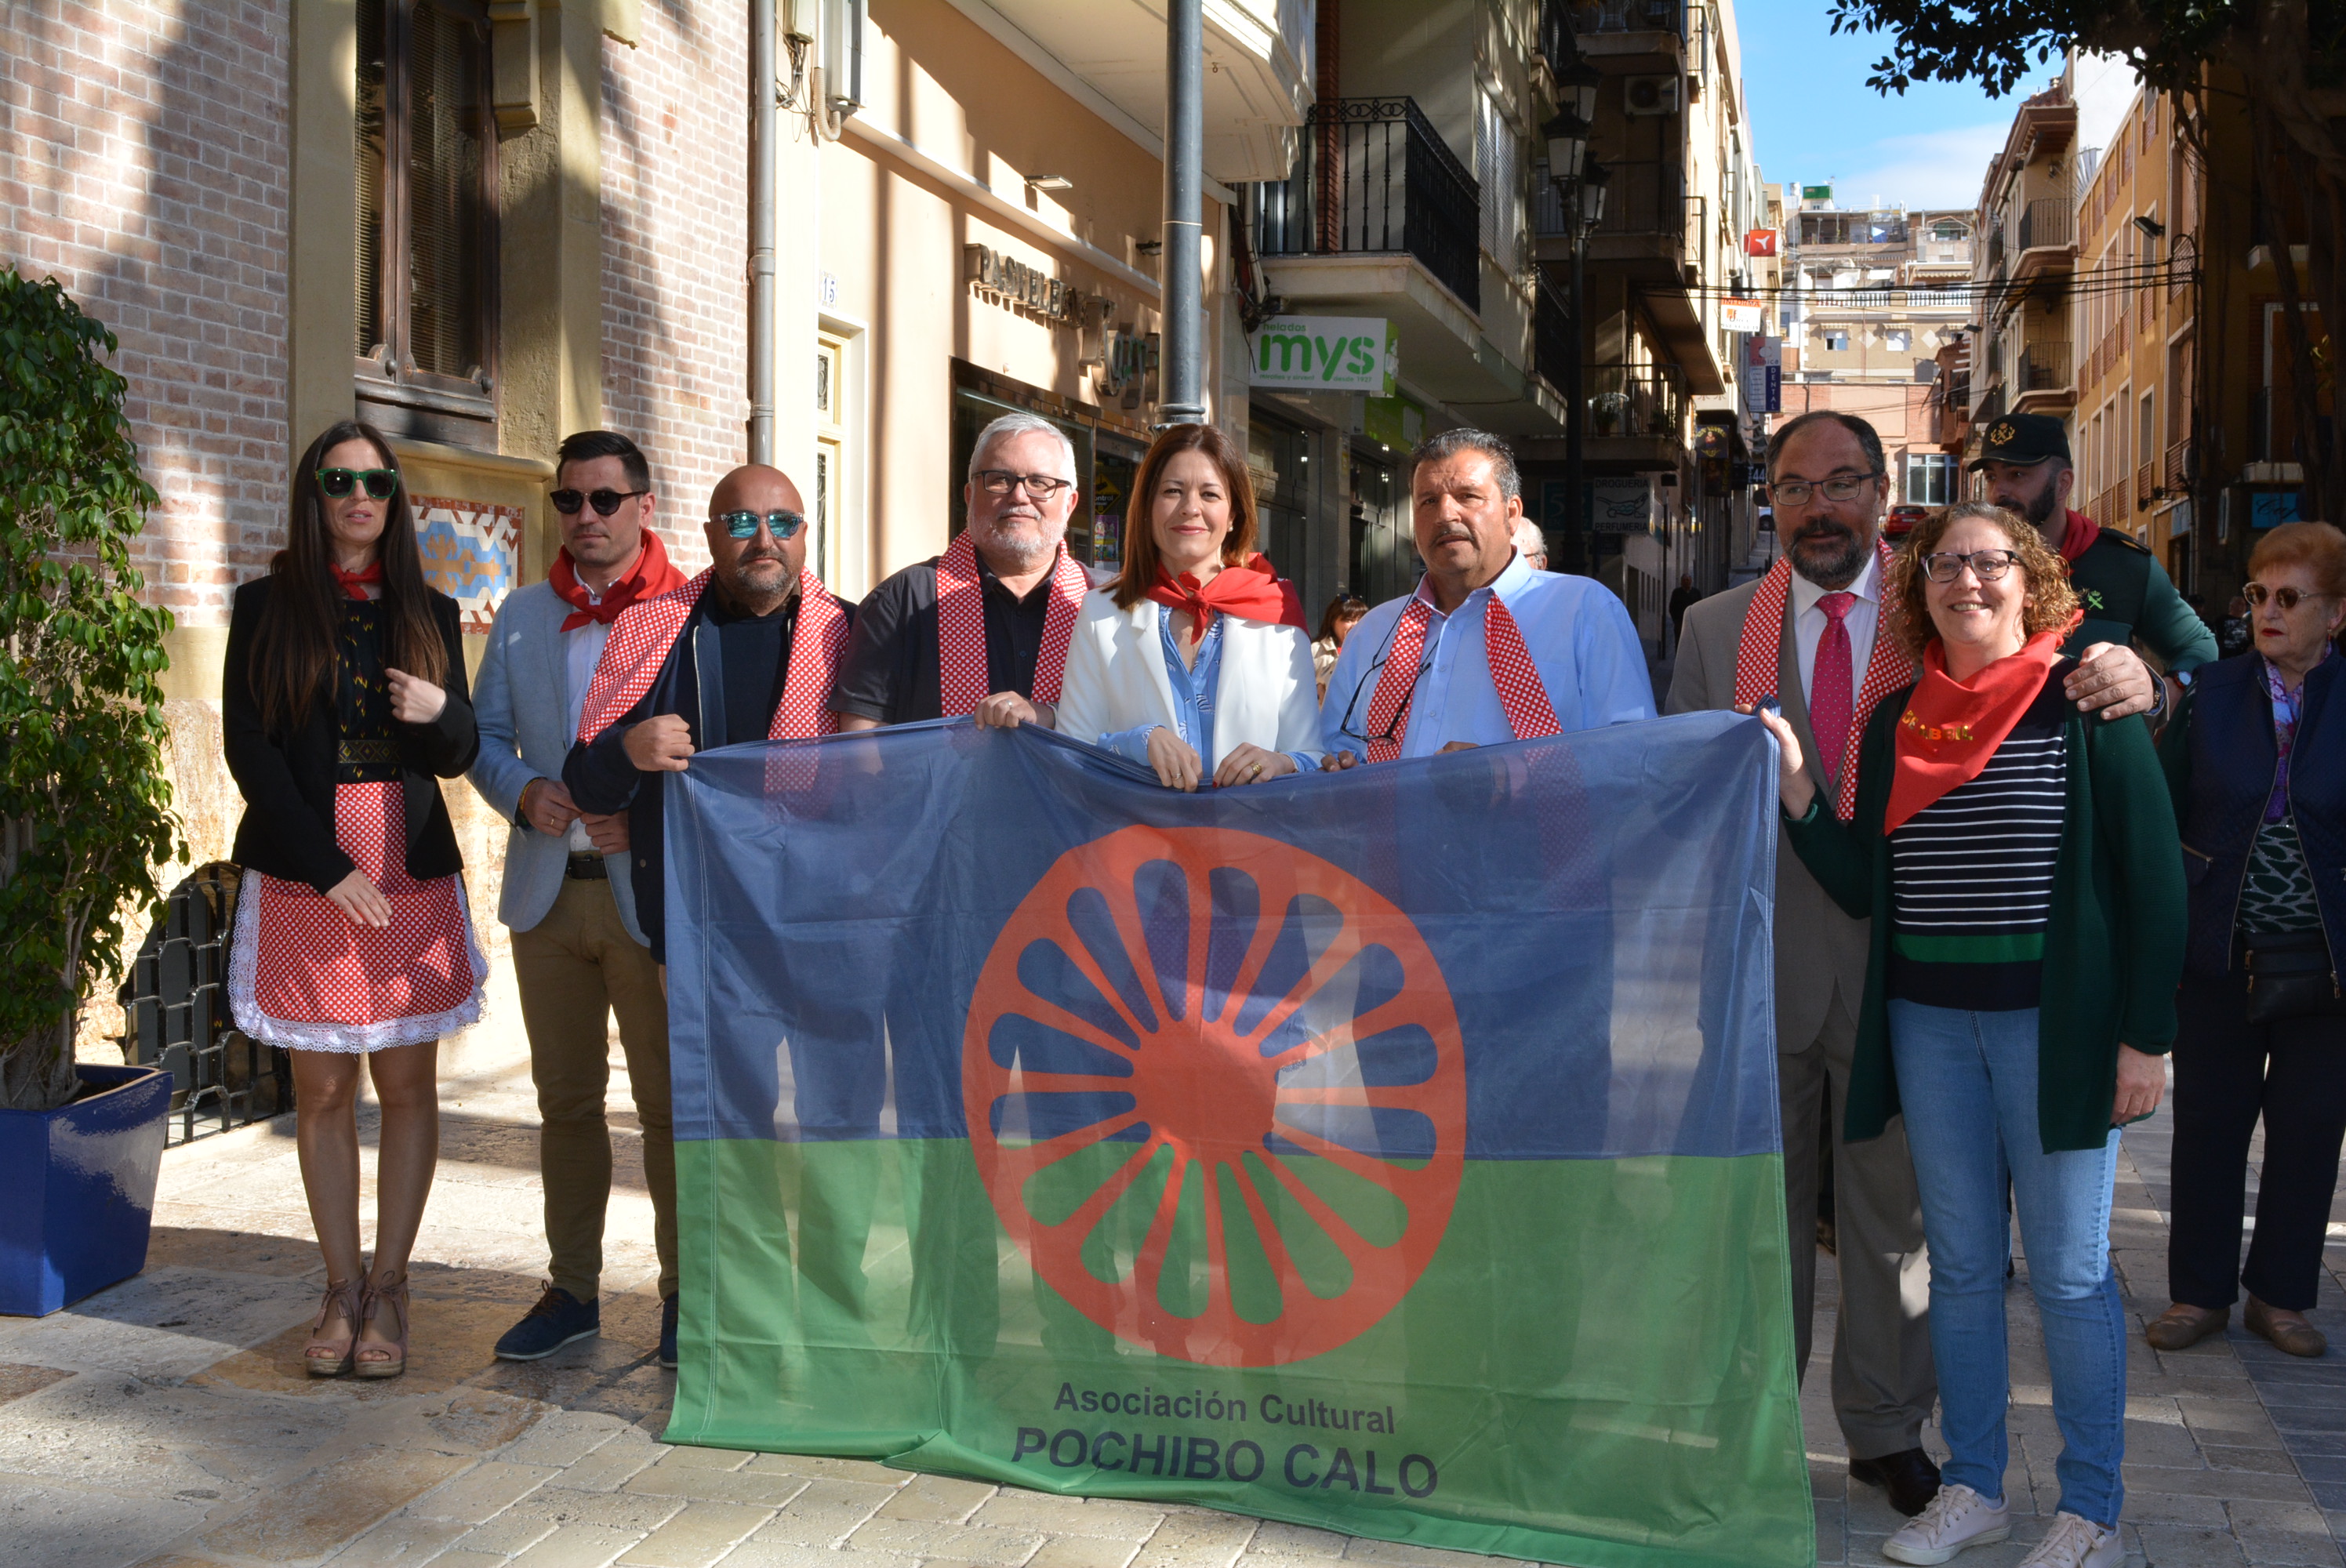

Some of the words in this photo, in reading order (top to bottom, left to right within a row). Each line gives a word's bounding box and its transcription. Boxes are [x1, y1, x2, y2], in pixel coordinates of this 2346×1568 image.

[824, 278, 834, 303] 15
[1263, 323, 1306, 332] helados
[1259, 334, 1375, 381] mys
[1596, 479, 1648, 488] DROGUERIA
[1595, 522, 1647, 532] PERFUMERIA
[1054, 1381, 1247, 1422] Asociación
[1259, 1393, 1395, 1434] Cultural
[1011, 1427, 1265, 1481] POCHIBO
[1284, 1443, 1438, 1498] CALO
